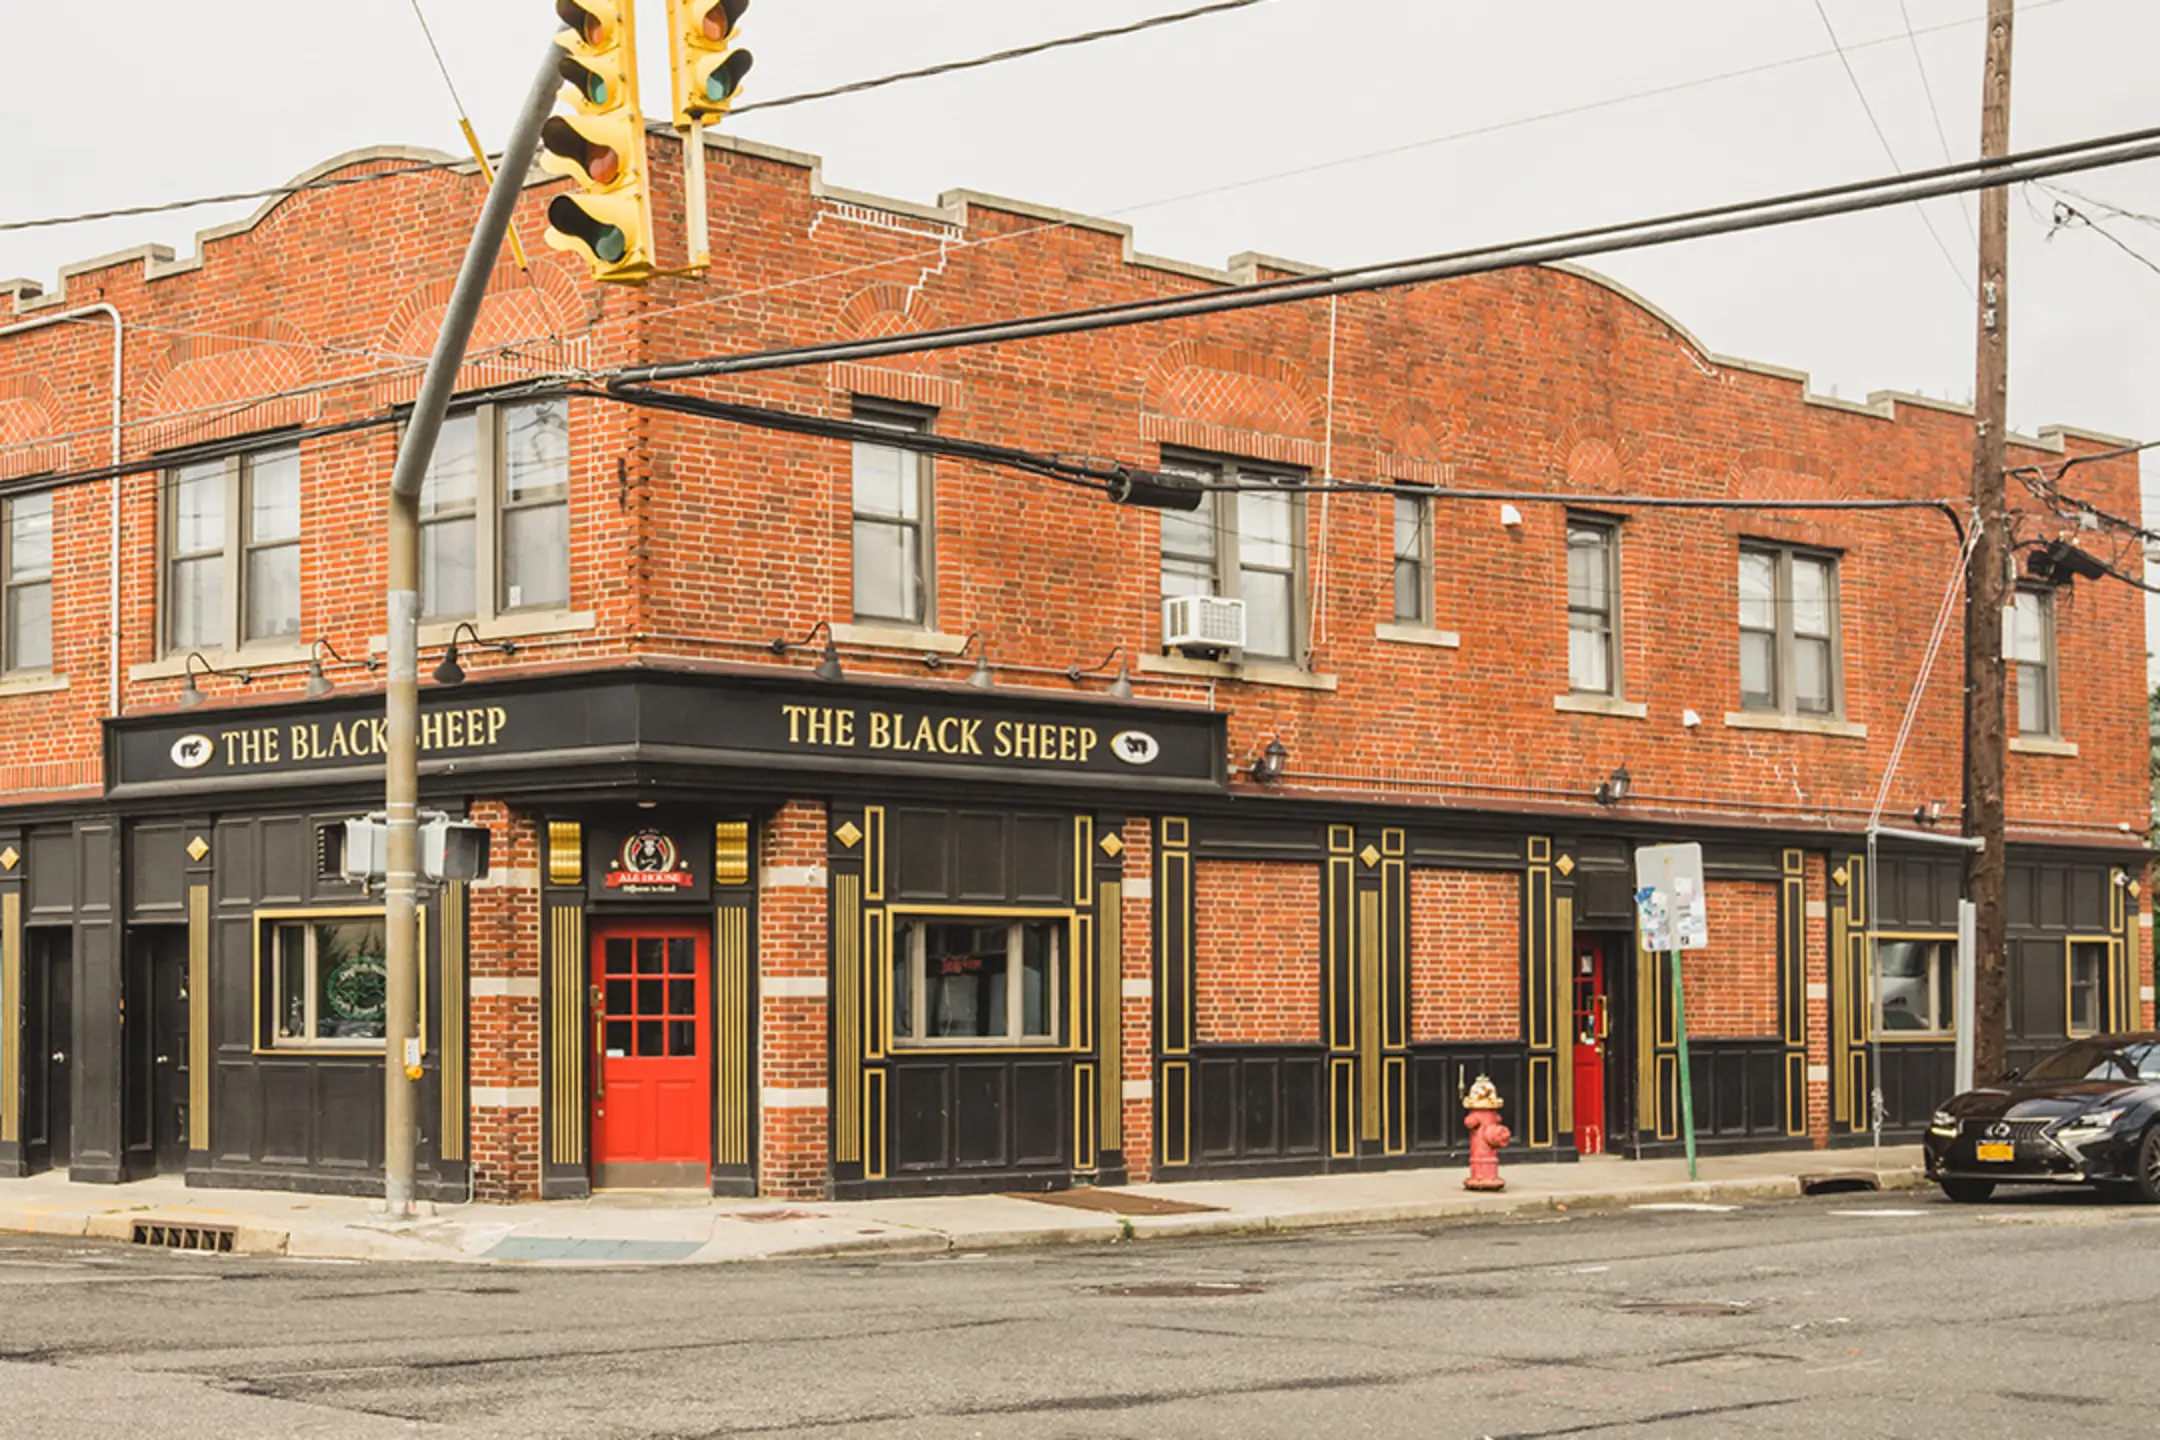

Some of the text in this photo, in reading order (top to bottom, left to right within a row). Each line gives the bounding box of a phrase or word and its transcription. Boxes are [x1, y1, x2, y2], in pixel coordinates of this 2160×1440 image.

[221, 706, 507, 766] THE BLACK HEEP
[782, 705, 1098, 762] THE BLACK SHEEP
[619, 872, 680, 882] ALE HOUSE
